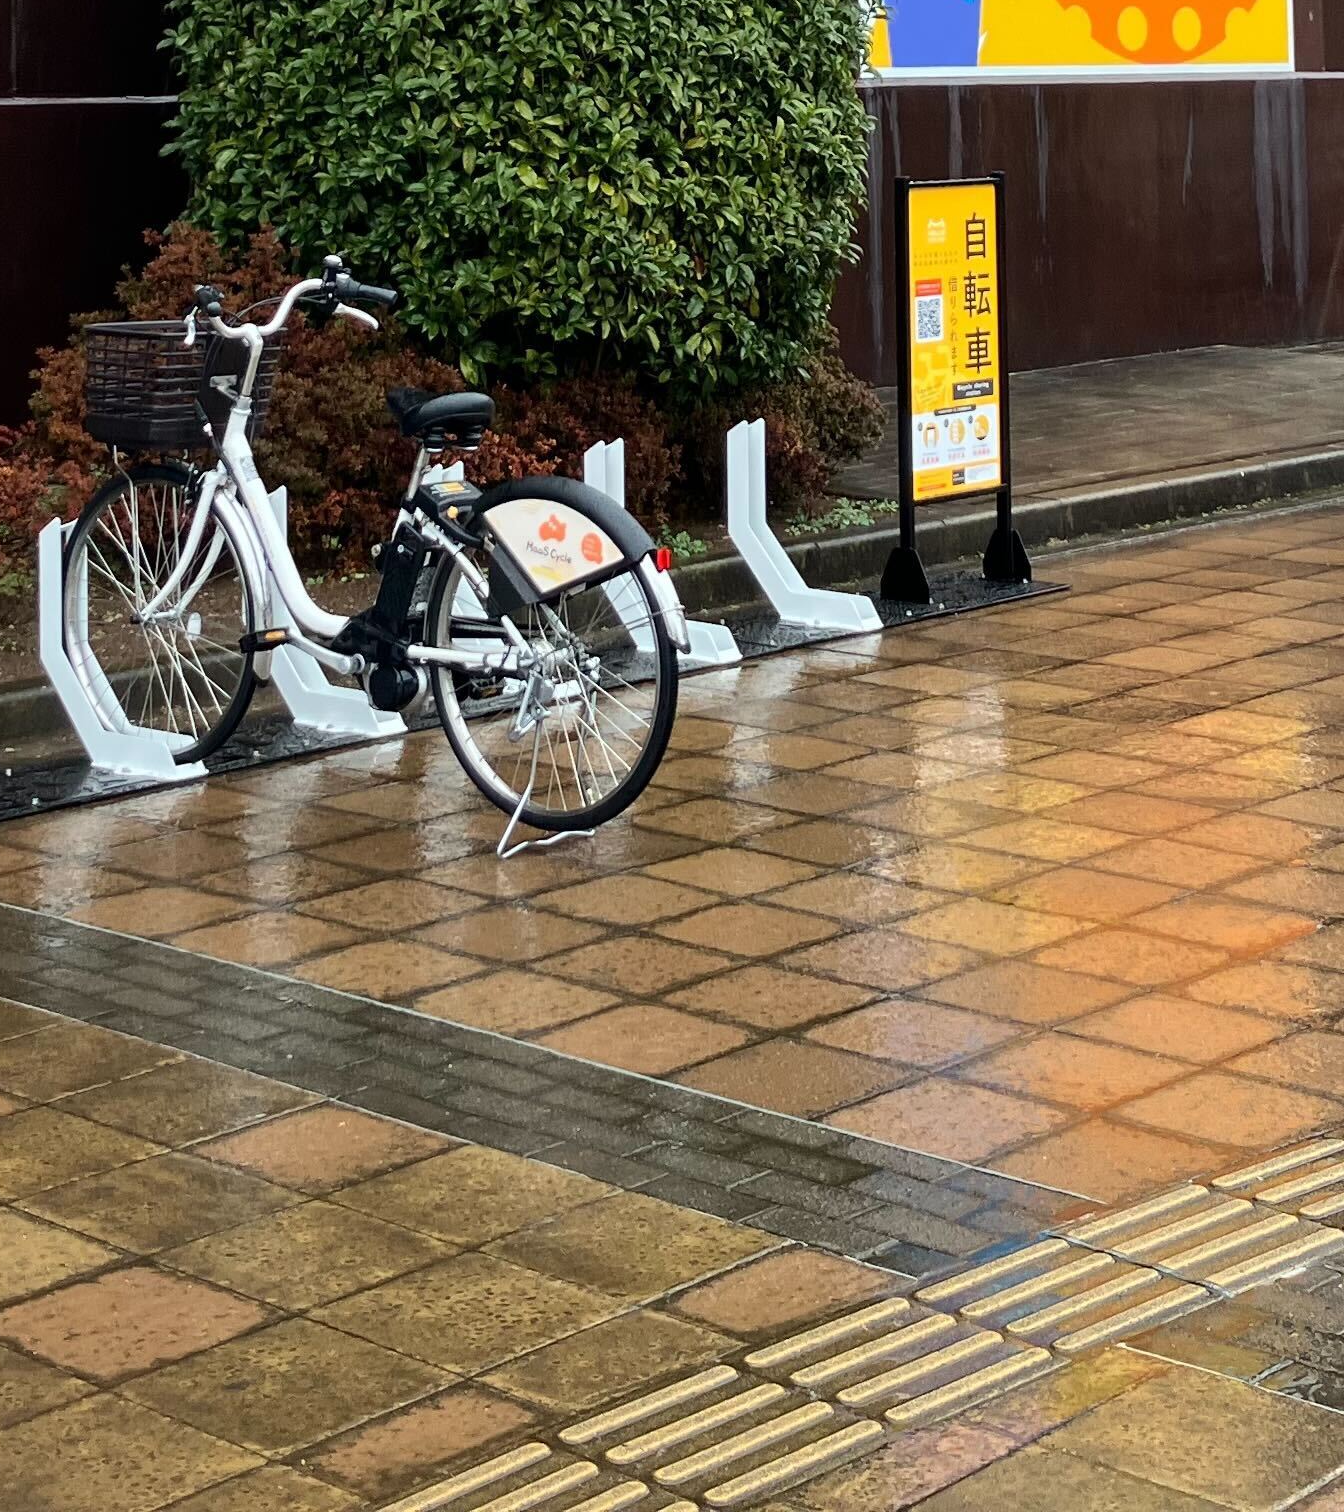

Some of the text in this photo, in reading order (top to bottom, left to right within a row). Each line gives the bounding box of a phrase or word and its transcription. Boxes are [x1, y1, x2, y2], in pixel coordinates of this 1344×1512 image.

[963, 212, 992, 374] 自転車
[526, 540, 572, 563] MaaS Cycle
